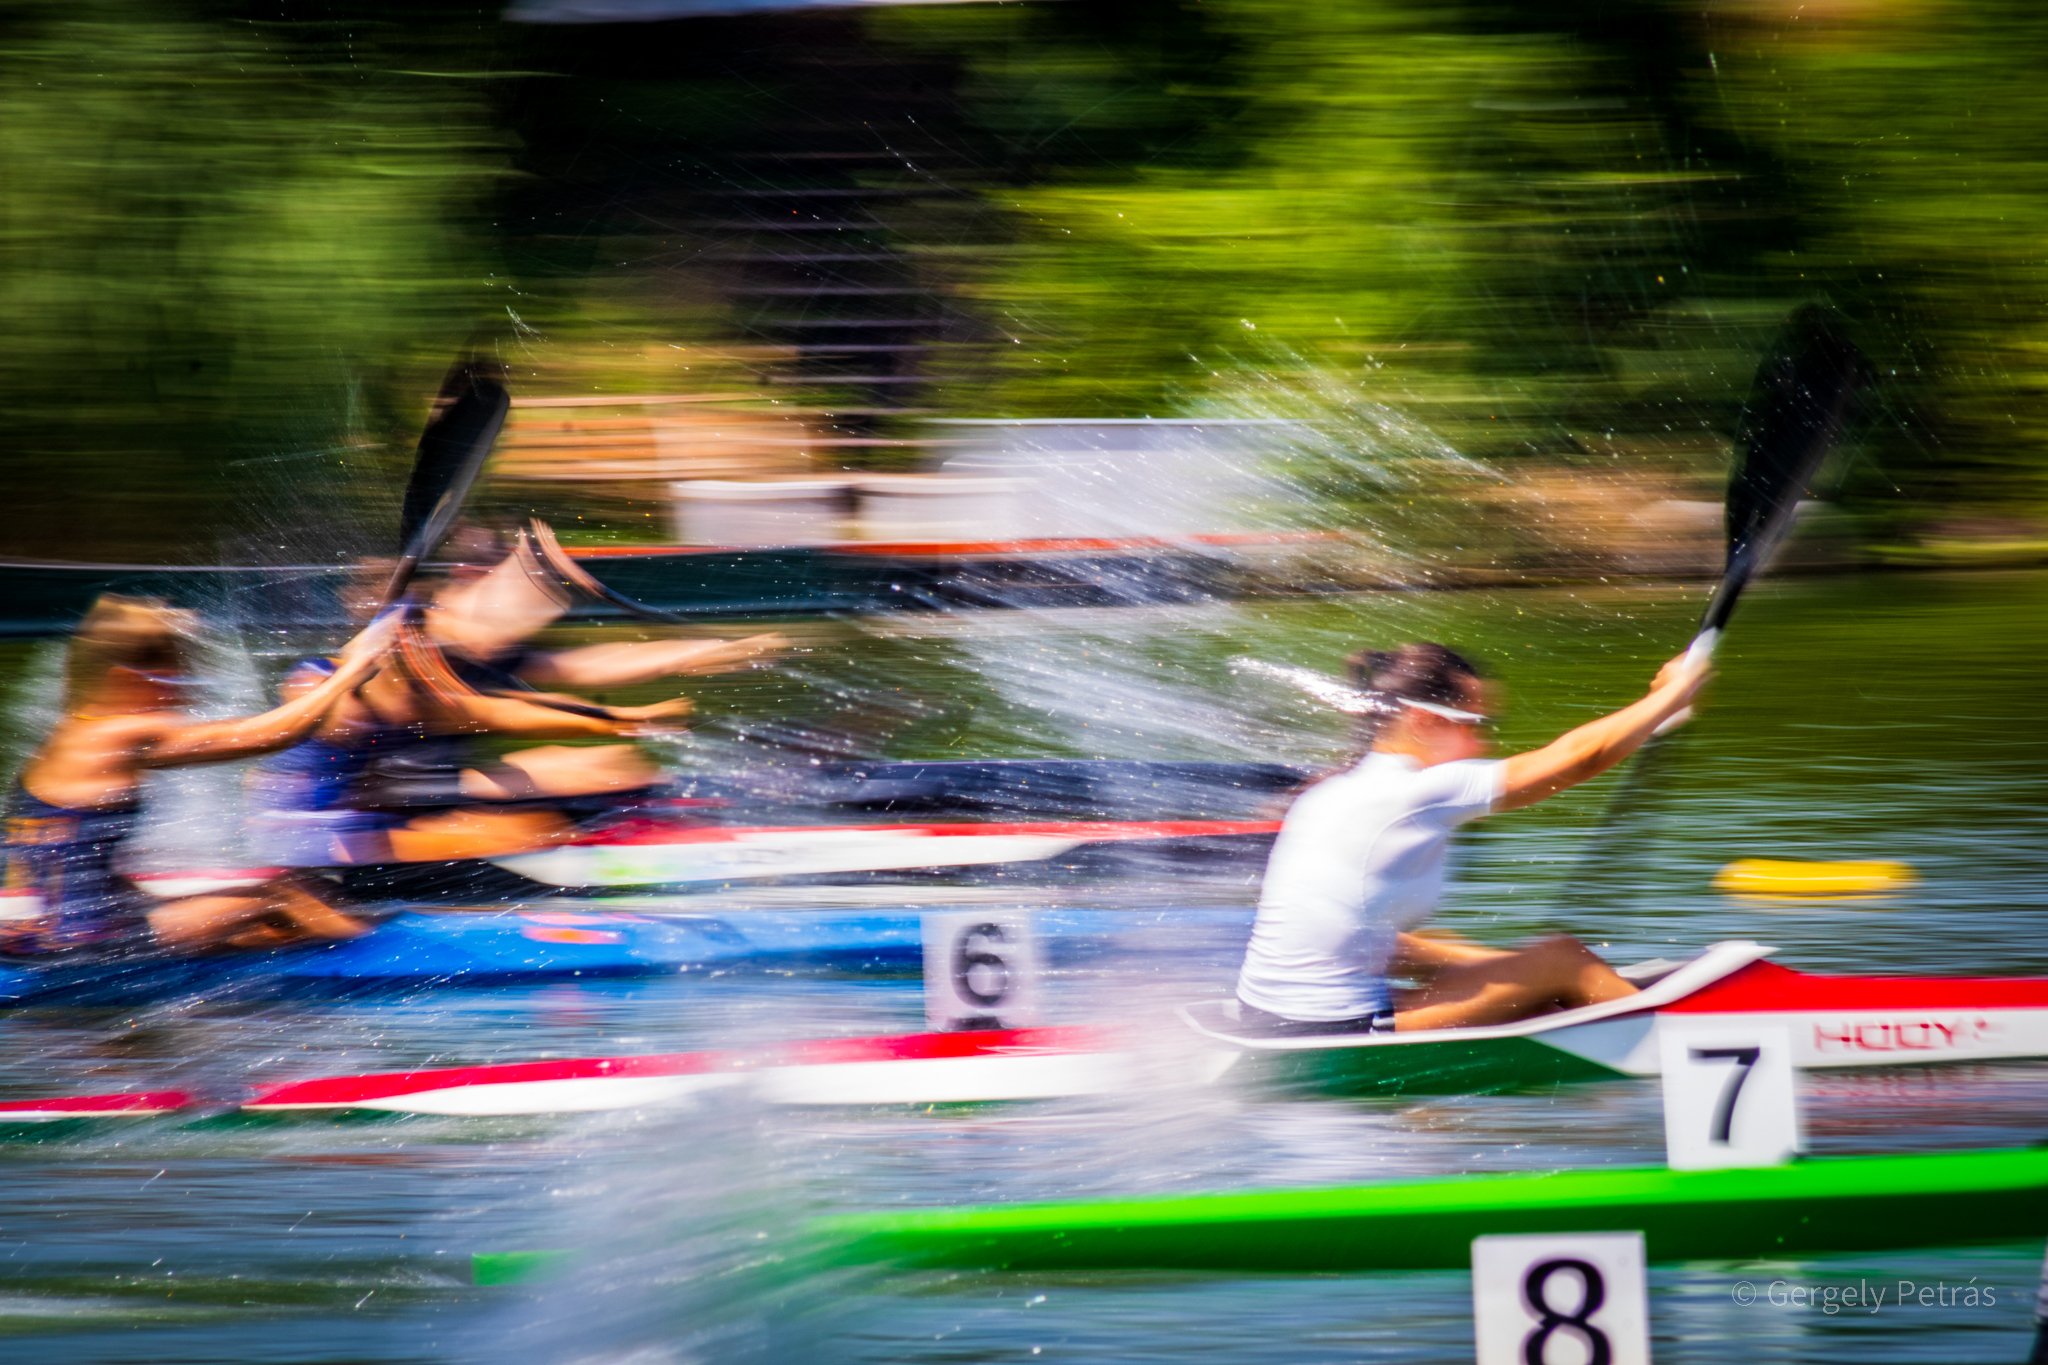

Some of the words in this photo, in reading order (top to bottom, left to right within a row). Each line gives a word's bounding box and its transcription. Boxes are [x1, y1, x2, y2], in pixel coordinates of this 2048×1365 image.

[952, 922, 1019, 1008] 6
[1687, 1045, 1761, 1146] 7
[1520, 1256, 1615, 1365] 8
